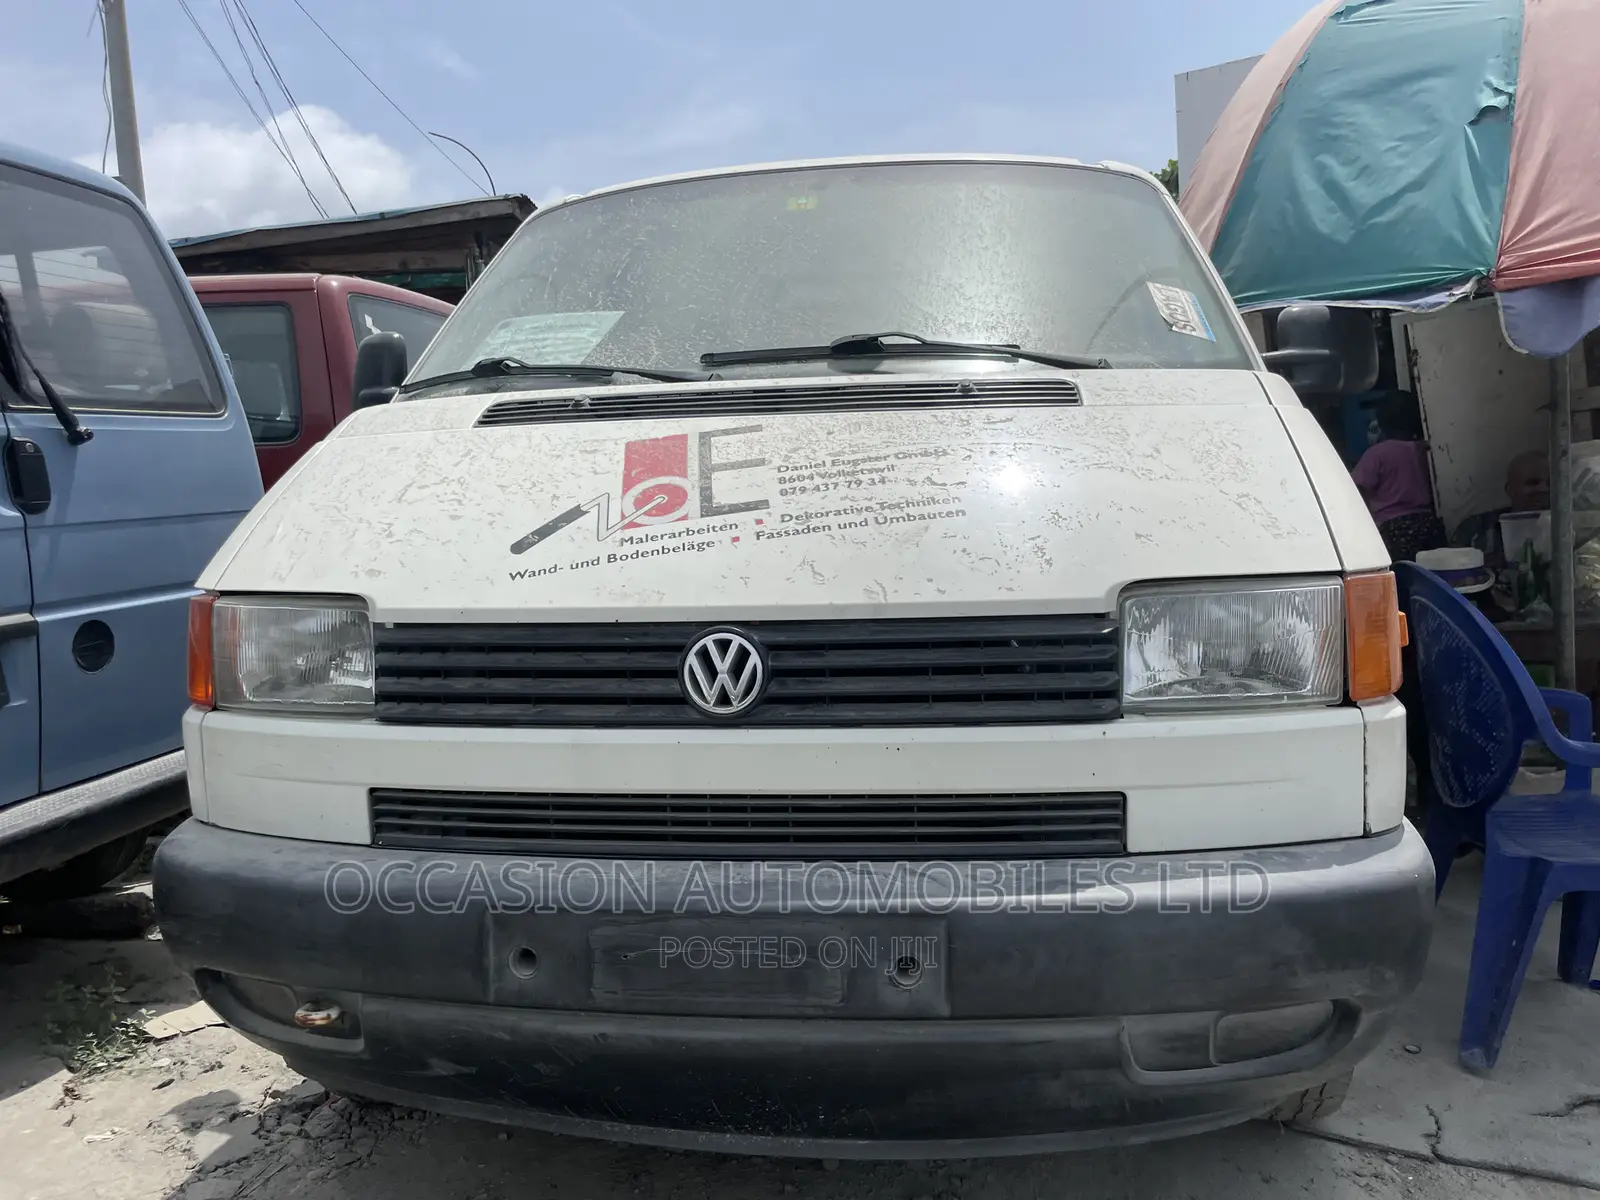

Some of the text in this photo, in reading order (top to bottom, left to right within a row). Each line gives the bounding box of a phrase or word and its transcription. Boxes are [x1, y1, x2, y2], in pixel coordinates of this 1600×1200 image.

[777, 460, 826, 473] Daniel
[830, 454, 890, 468] Eugster
[778, 474, 815, 485] 8604
[779, 486, 807, 497] 079
[812, 482, 840, 492] 437
[844, 479, 863, 489] 79
[619, 496, 961, 547] Malerarbeiten Dekorative Techniken
[508, 508, 967, 581] Wand- und Bodenbeläge Fassaden und Umbauten
[683, 632, 763, 714] VW
